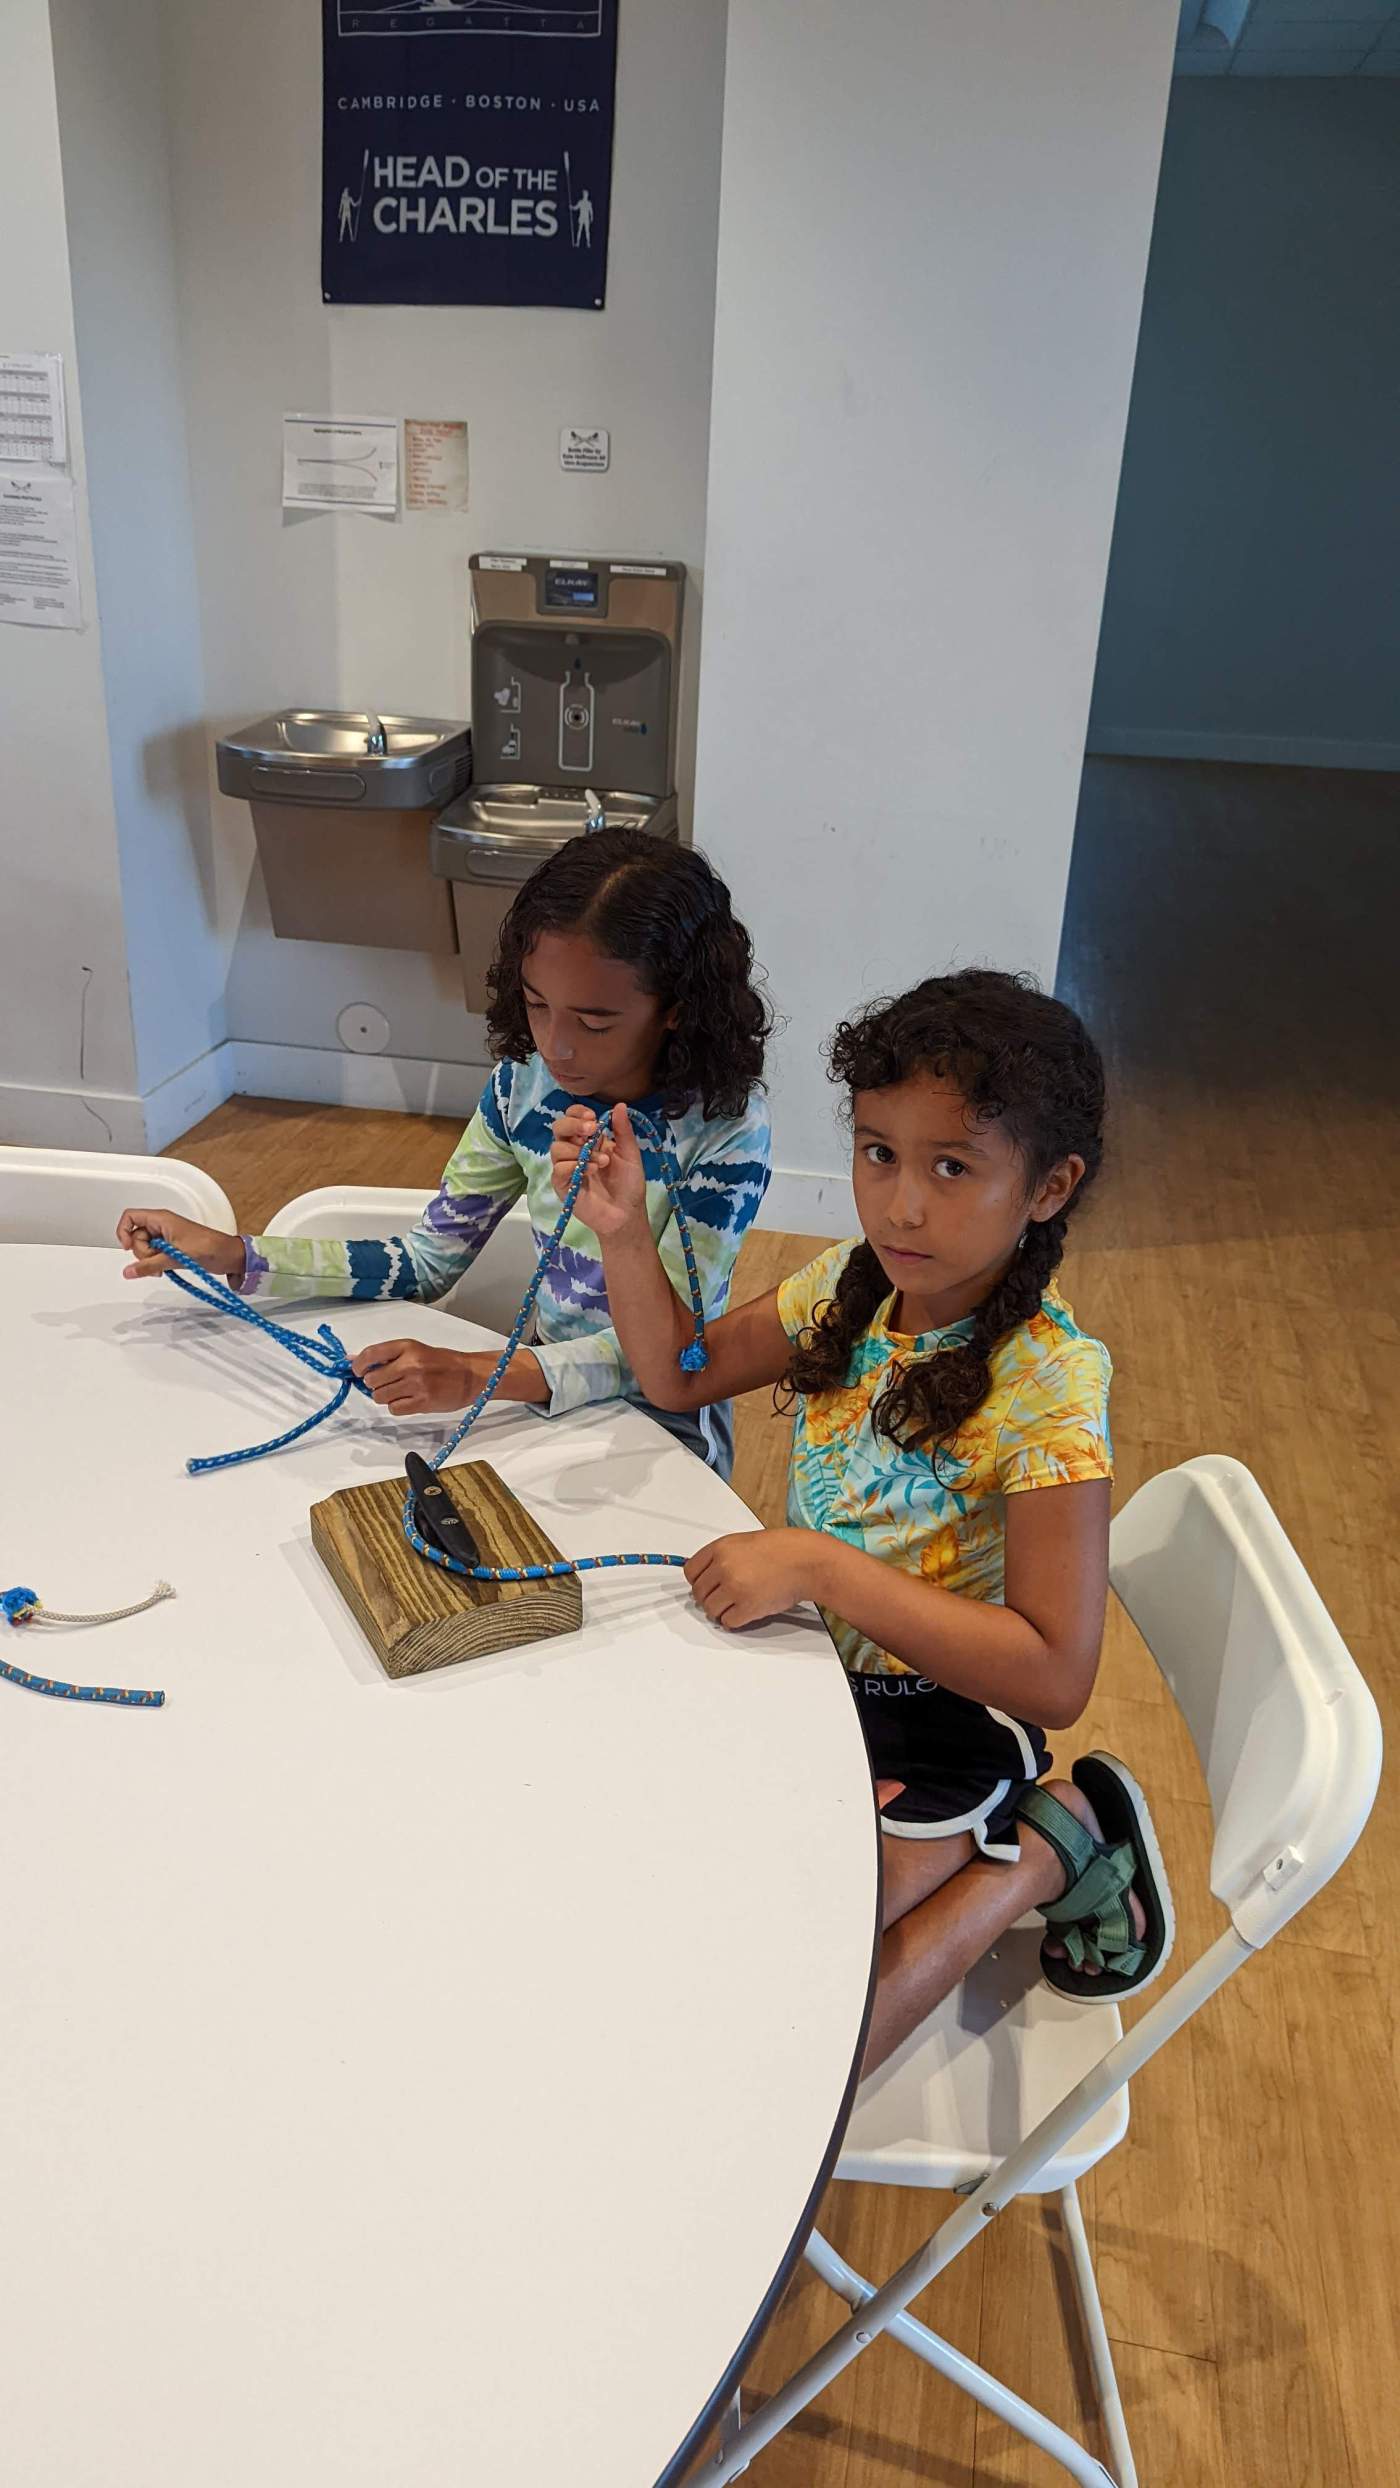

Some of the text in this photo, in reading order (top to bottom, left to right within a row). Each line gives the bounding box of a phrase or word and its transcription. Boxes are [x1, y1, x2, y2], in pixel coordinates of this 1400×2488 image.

[351, 16, 585, 30] REGATTA
[337, 95, 600, 112] CAMBRIDGE BOSTON USA
[374, 156, 558, 191] HEAD OF THE
[373, 196, 558, 237] CHARLES
